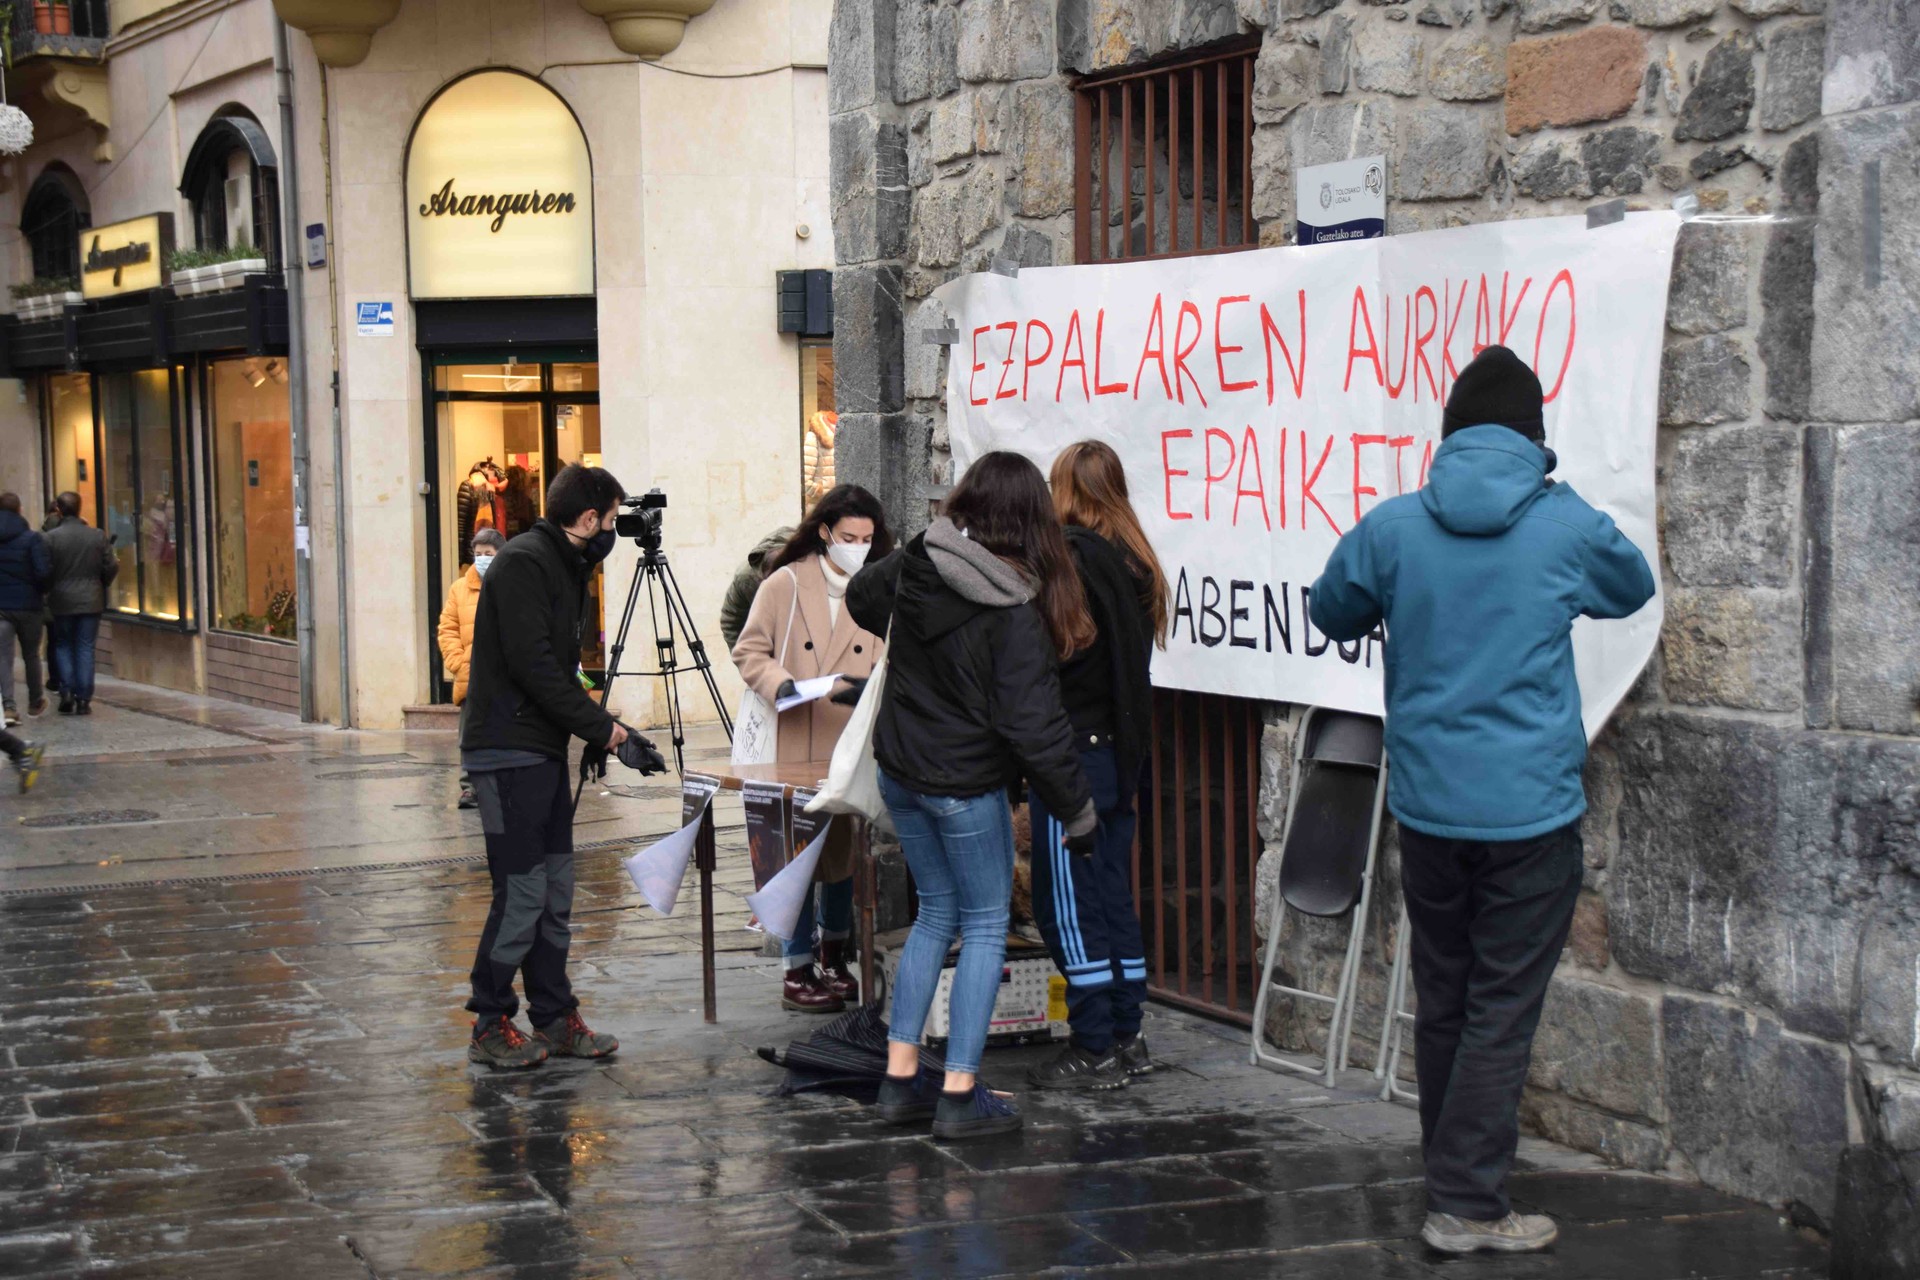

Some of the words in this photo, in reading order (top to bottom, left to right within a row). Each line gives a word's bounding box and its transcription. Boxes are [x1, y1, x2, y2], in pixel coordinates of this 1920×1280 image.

[419, 178, 576, 233] Aranguren
[1316, 229, 1349, 242] Gaztelako
[1350, 229, 1364, 238] atea
[970, 289, 1306, 408] EZPALAREN
